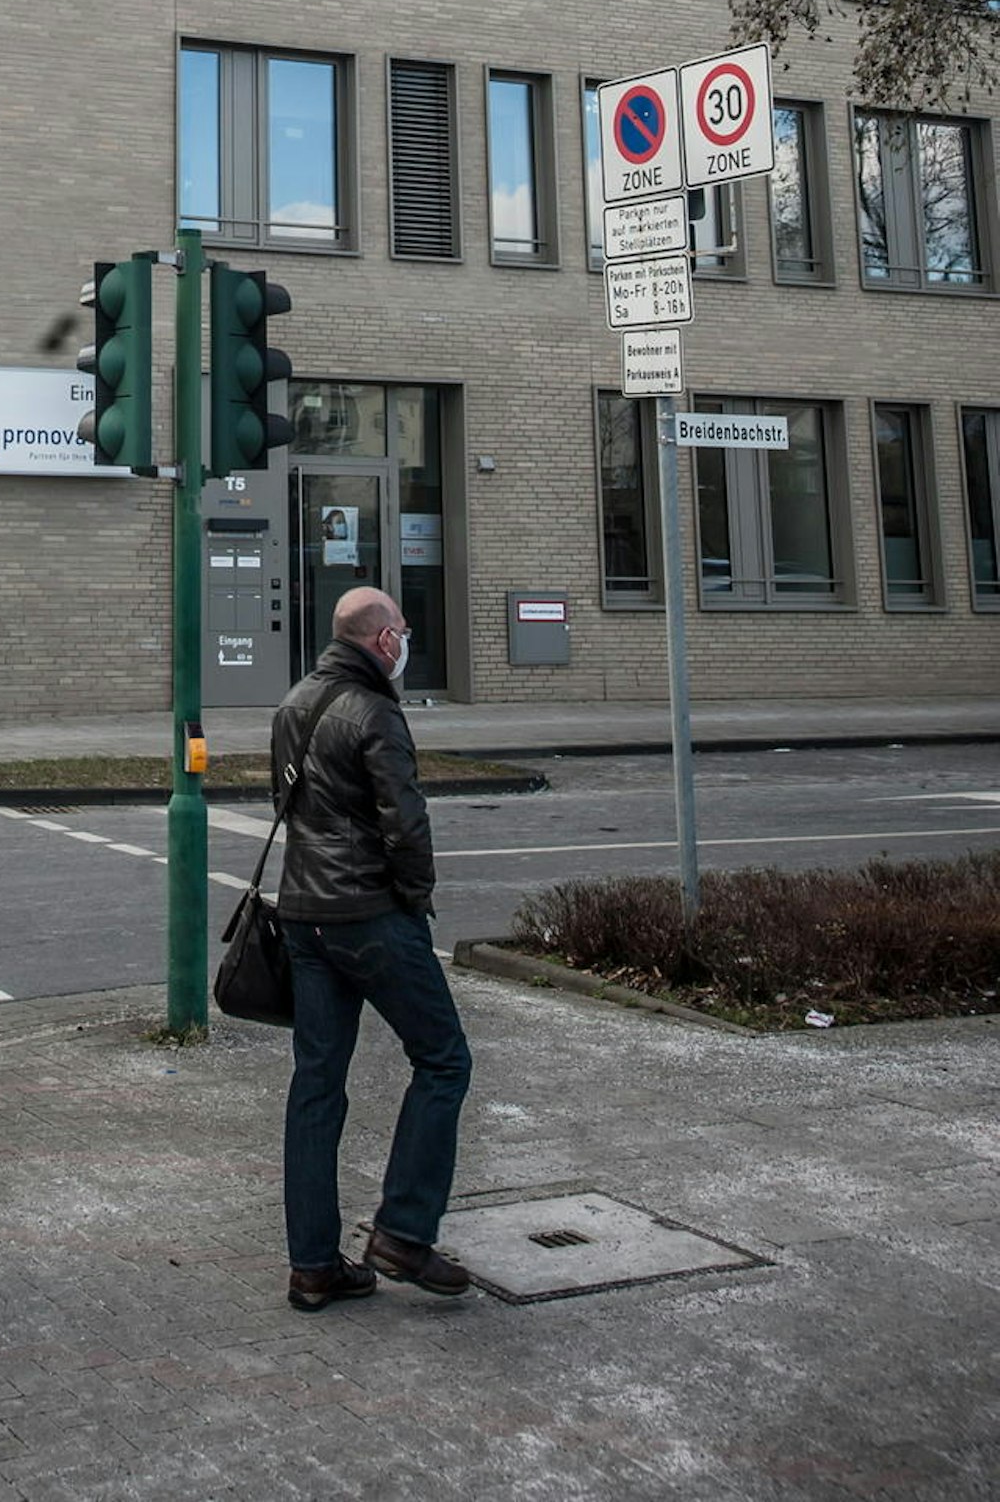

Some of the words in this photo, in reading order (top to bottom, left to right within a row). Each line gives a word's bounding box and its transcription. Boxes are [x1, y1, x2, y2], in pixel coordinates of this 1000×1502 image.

[708, 84, 742, 126] 30
[706, 147, 752, 175] ZONE
[622, 165, 663, 192] ZONE
[619, 207, 651, 220] Parken
[653, 203, 668, 215] nur
[612, 224, 626, 237] auf
[629, 217, 679, 234] markierten
[610, 269, 633, 282] Parken
[634, 267, 646, 279] mit
[648, 264, 685, 278] Parkschein
[613, 284, 647, 300] Mo-Fr
[615, 304, 629, 319] Sa
[627, 344, 663, 357] Bewohner
[664, 343, 677, 355] mit
[627, 368, 672, 381] Parkausweis
[674, 366, 680, 378] A
[70, 384, 95, 401] Ein
[680, 420, 786, 442] Breidenbachstr.
